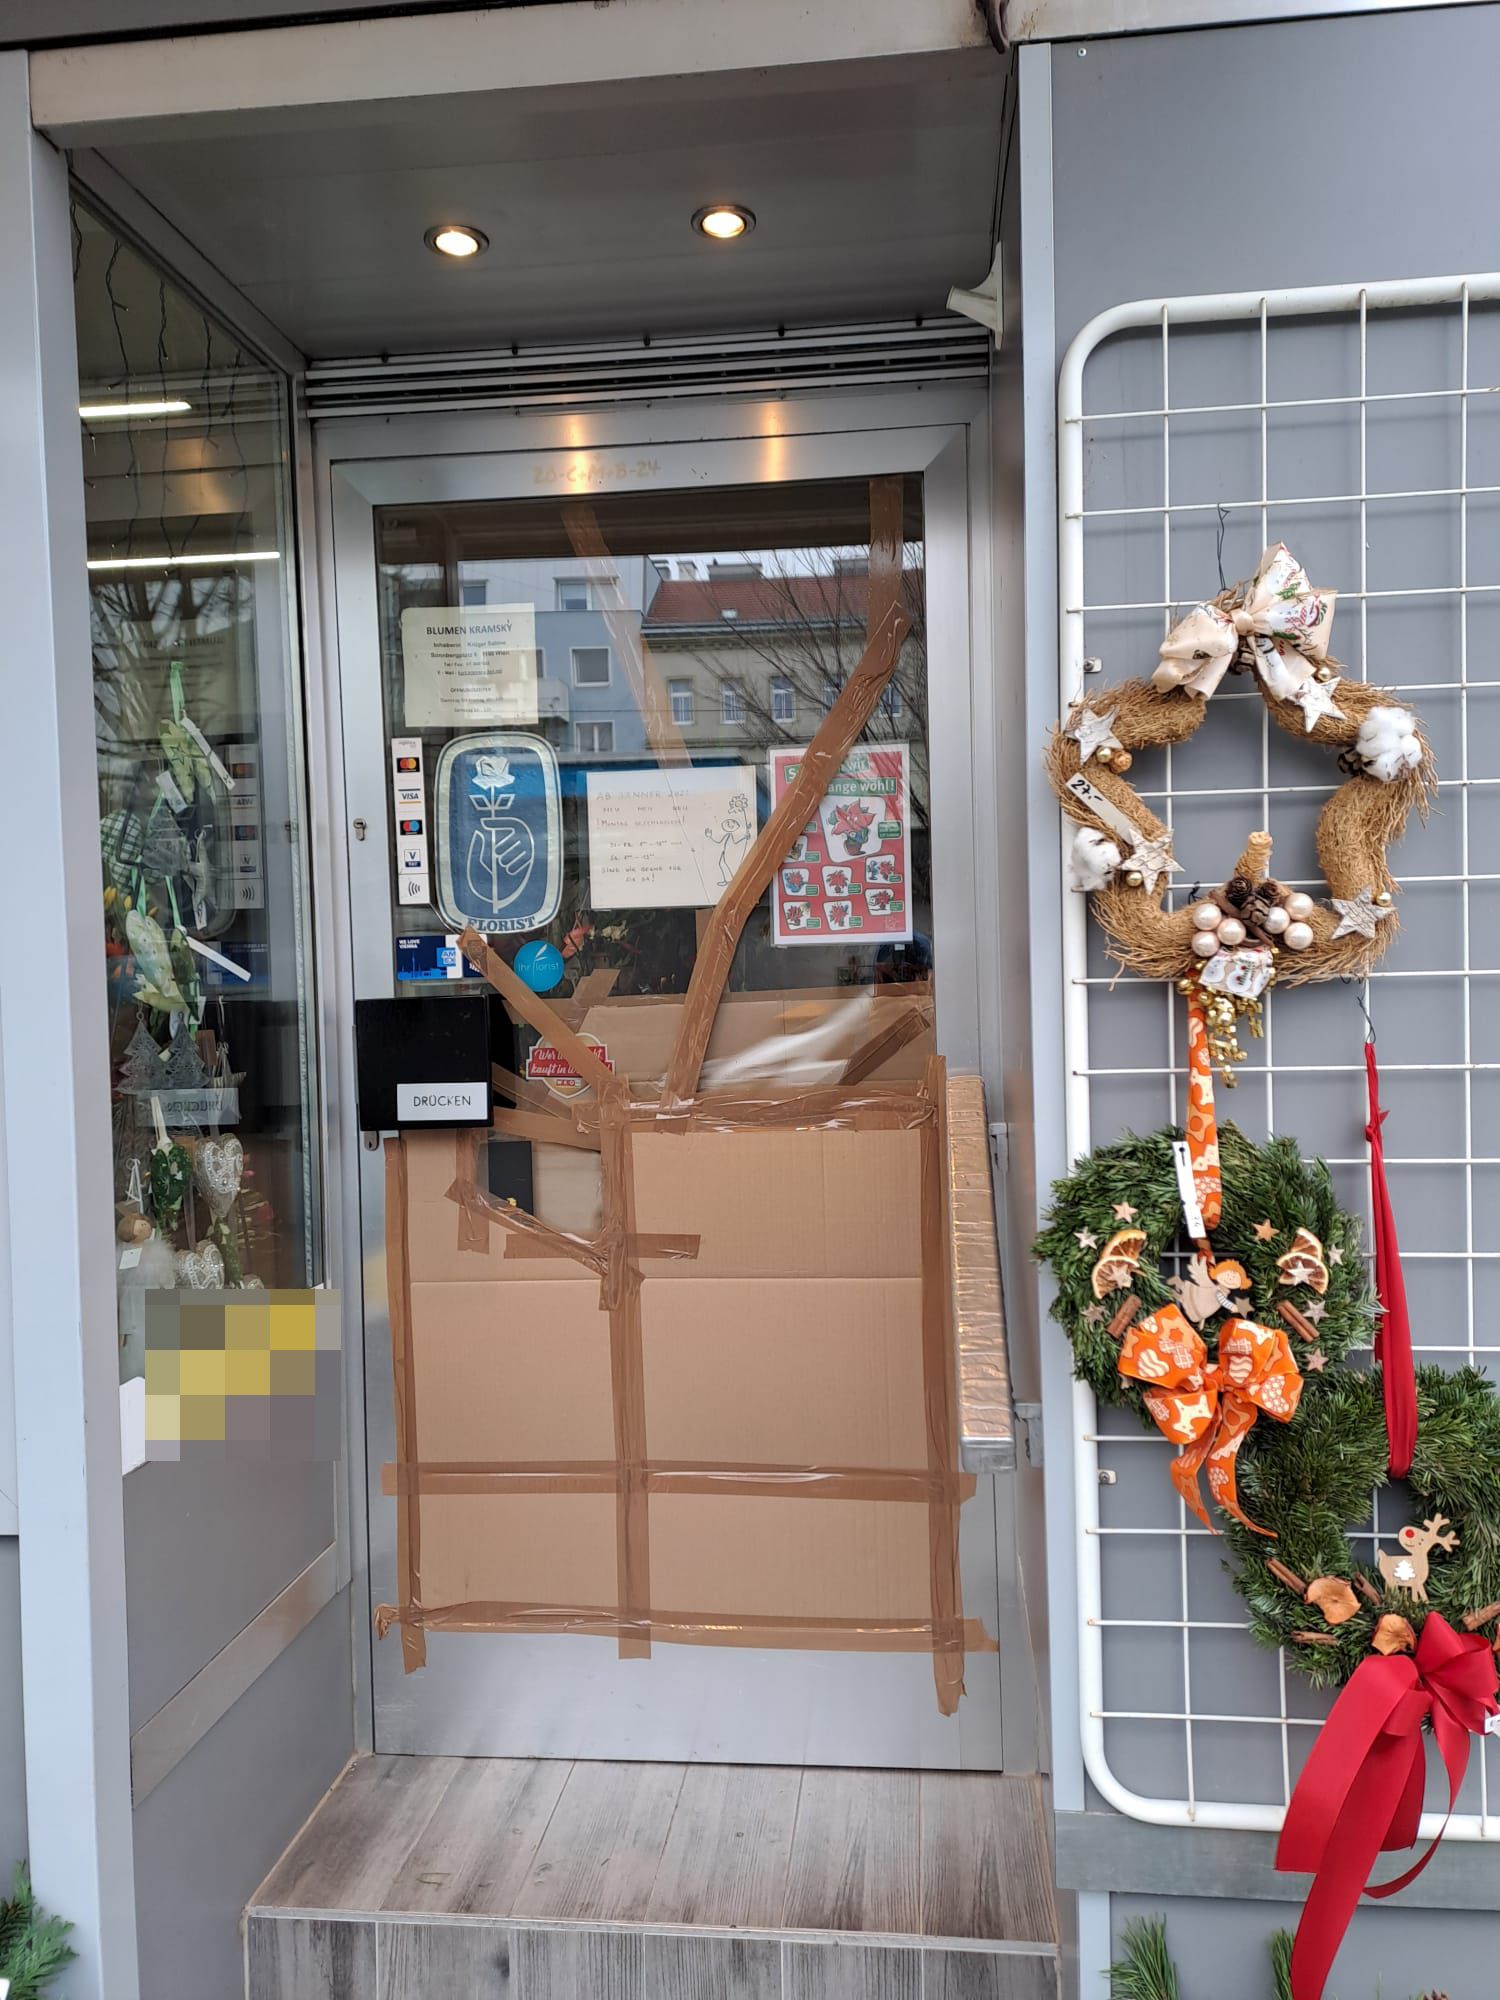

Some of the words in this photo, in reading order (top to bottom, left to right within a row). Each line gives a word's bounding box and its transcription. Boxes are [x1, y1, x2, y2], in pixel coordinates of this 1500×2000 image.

[426, 626, 467, 635] BLUMEN
[827, 783, 857, 794] ange
[859, 779, 895, 792] wohl!
[467, 916, 536, 932] FLORIST
[518, 963, 532, 972] Ihr
[530, 1063, 556, 1076] kauft
[557, 1062, 566, 1074] in
[413, 1095, 471, 1107] DRÜCKEN
